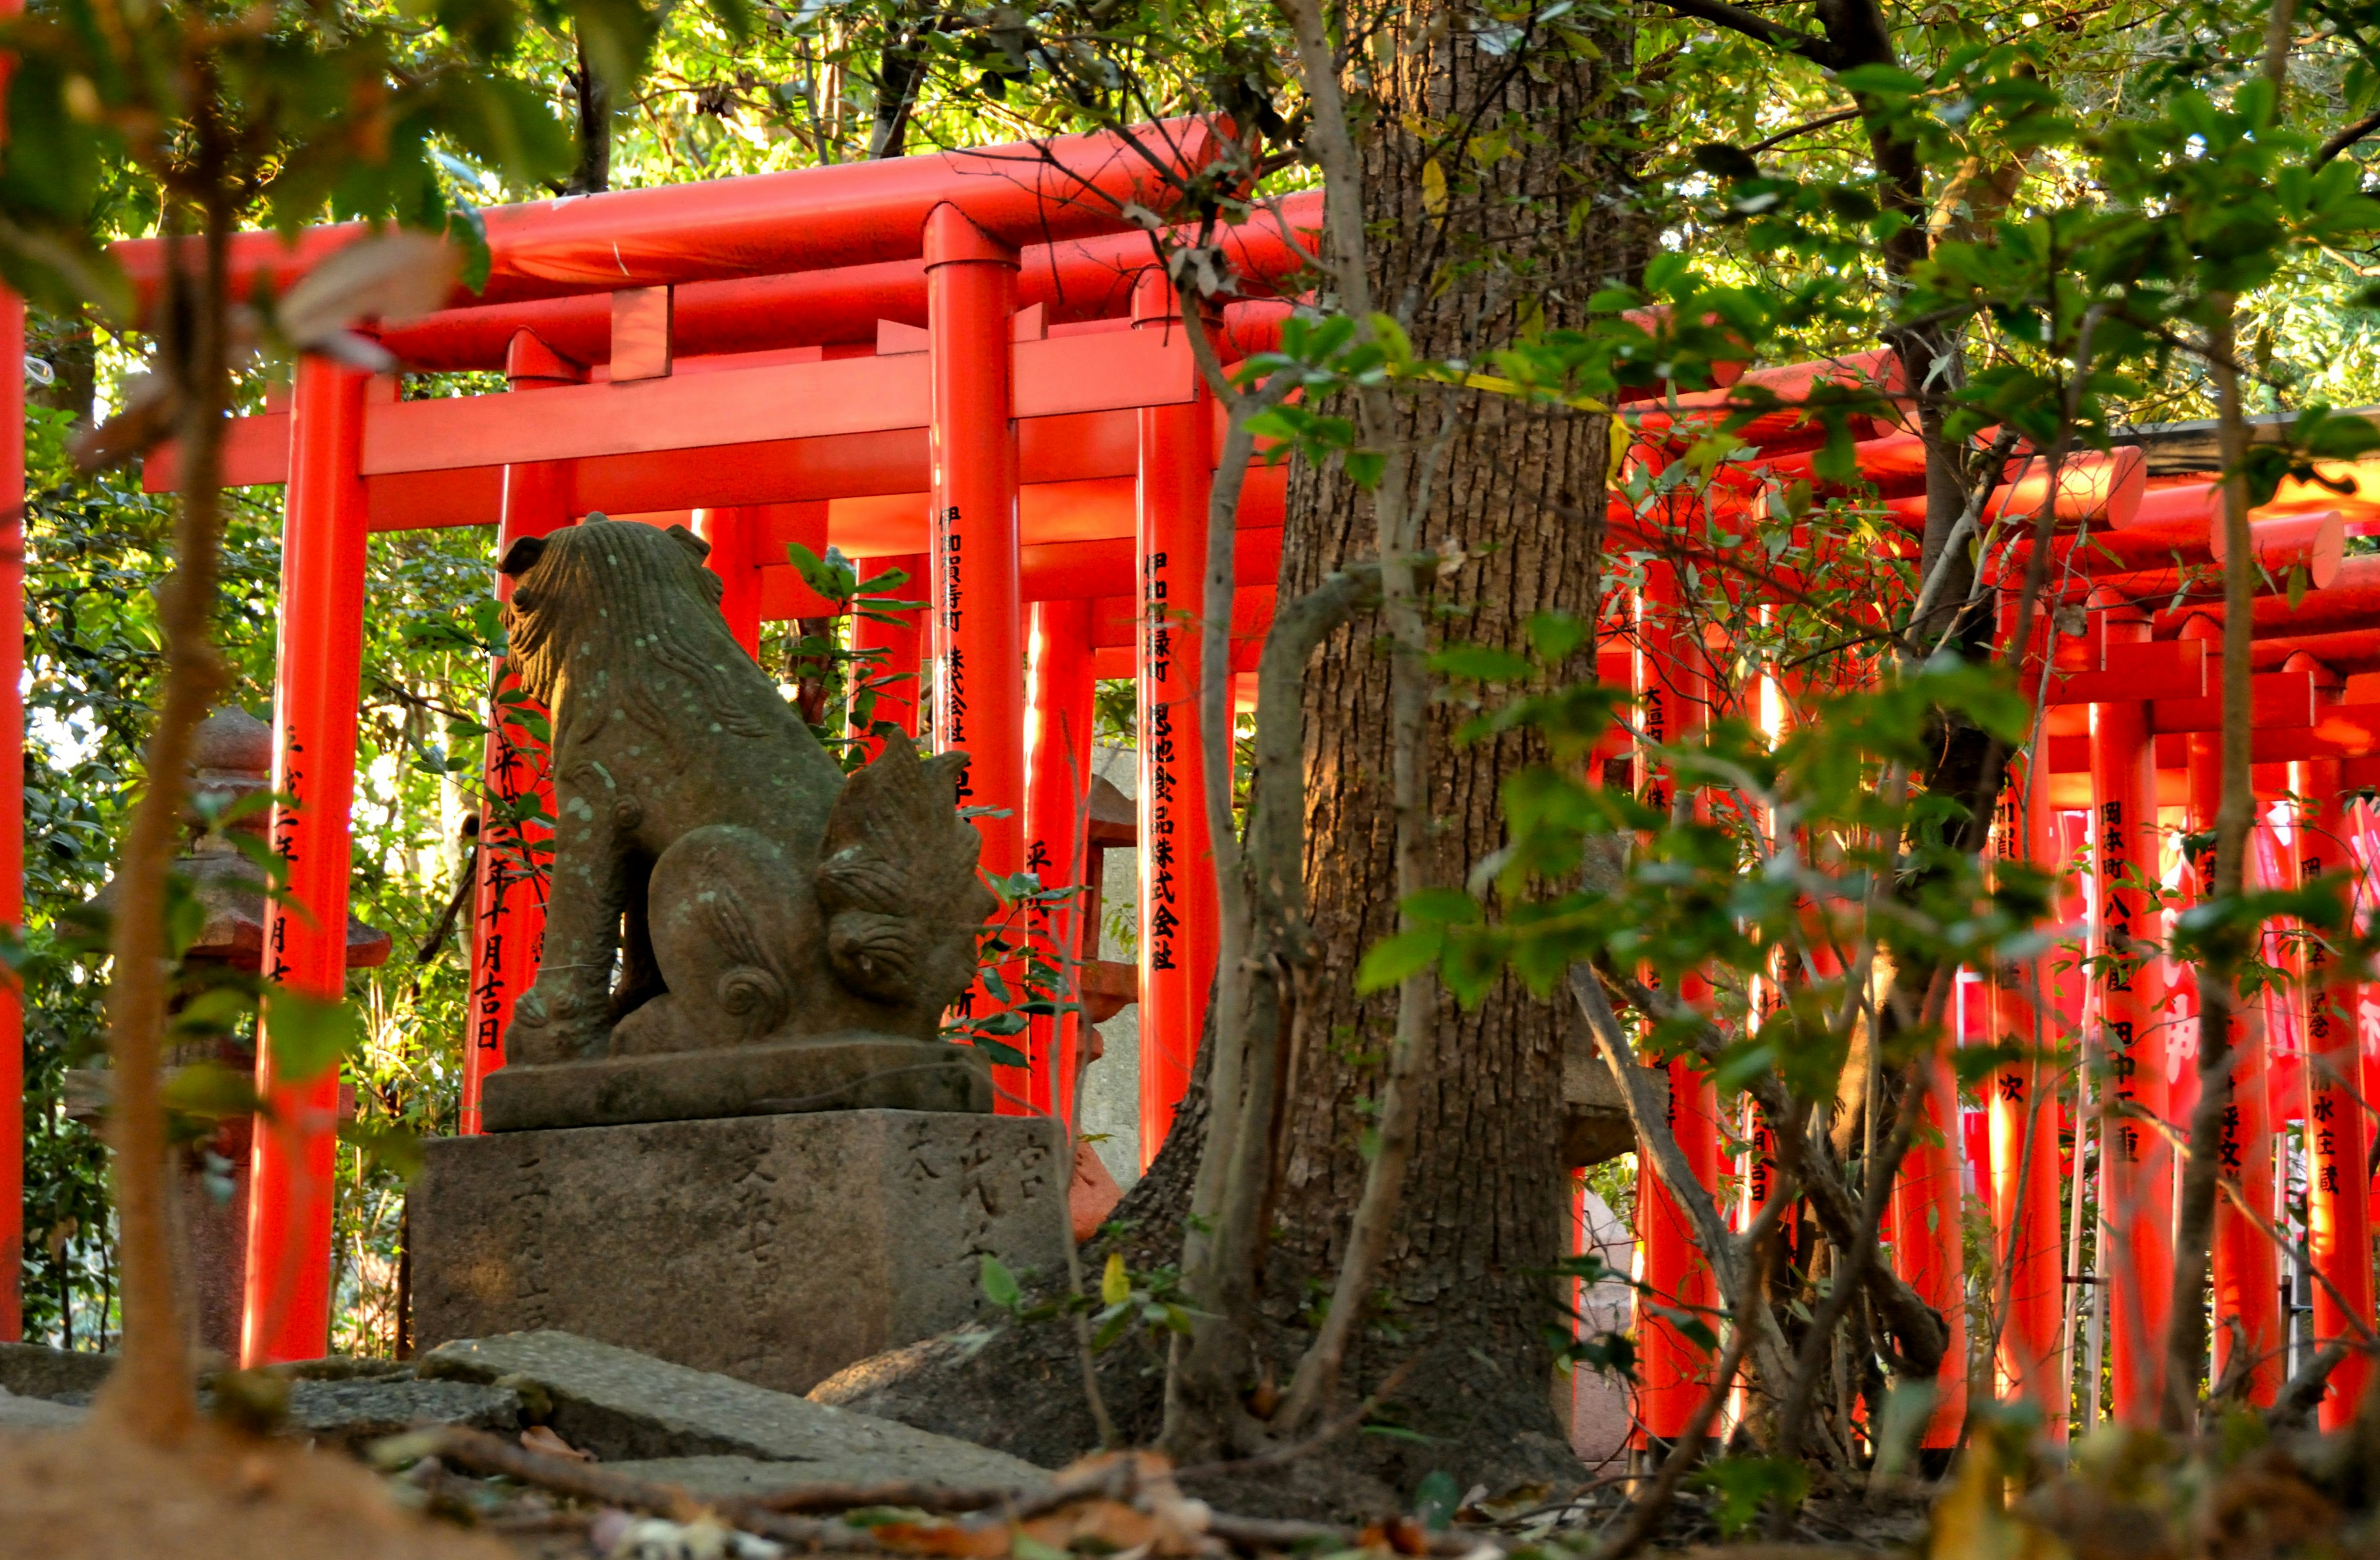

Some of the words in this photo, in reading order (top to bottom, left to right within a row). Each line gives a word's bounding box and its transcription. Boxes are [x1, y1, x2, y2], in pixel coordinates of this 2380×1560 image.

[938, 506, 963, 632] 伊加賀寿町
[945, 644, 968, 744] 株式会社
[2100, 800, 2125, 879] 岡本町
